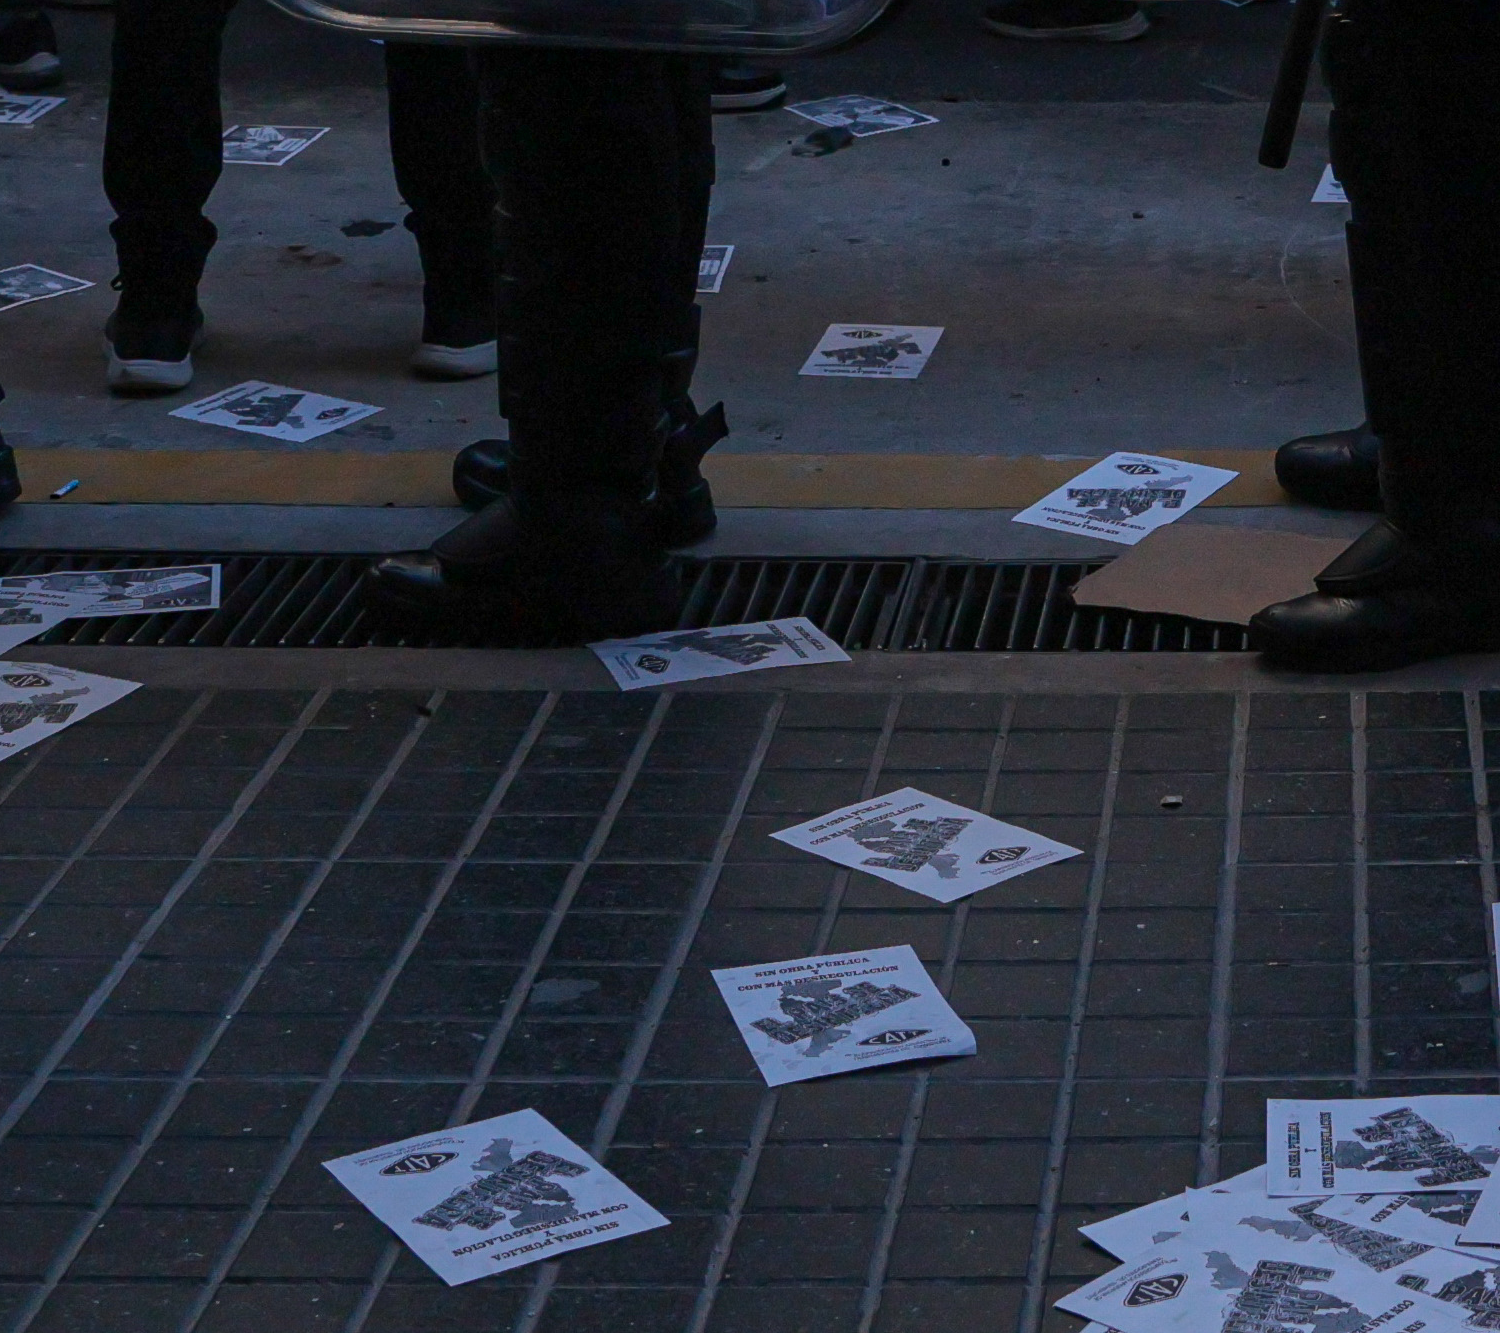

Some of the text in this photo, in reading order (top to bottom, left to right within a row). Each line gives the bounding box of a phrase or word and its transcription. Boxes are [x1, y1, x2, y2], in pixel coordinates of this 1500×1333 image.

[755, 968, 778, 978] SIN
[781, 963, 814, 975] OBRA
[869, 1030, 920, 1045] CATT
[395, 1154, 446, 1174] CATT
[605, 1202, 629, 1212] CON
[554, 1227, 593, 1243] OBRA
[596, 1221, 619, 1234] SIN
[1132, 1277, 1179, 1305] CATT
[1392, 1300, 1414, 1316] CON
